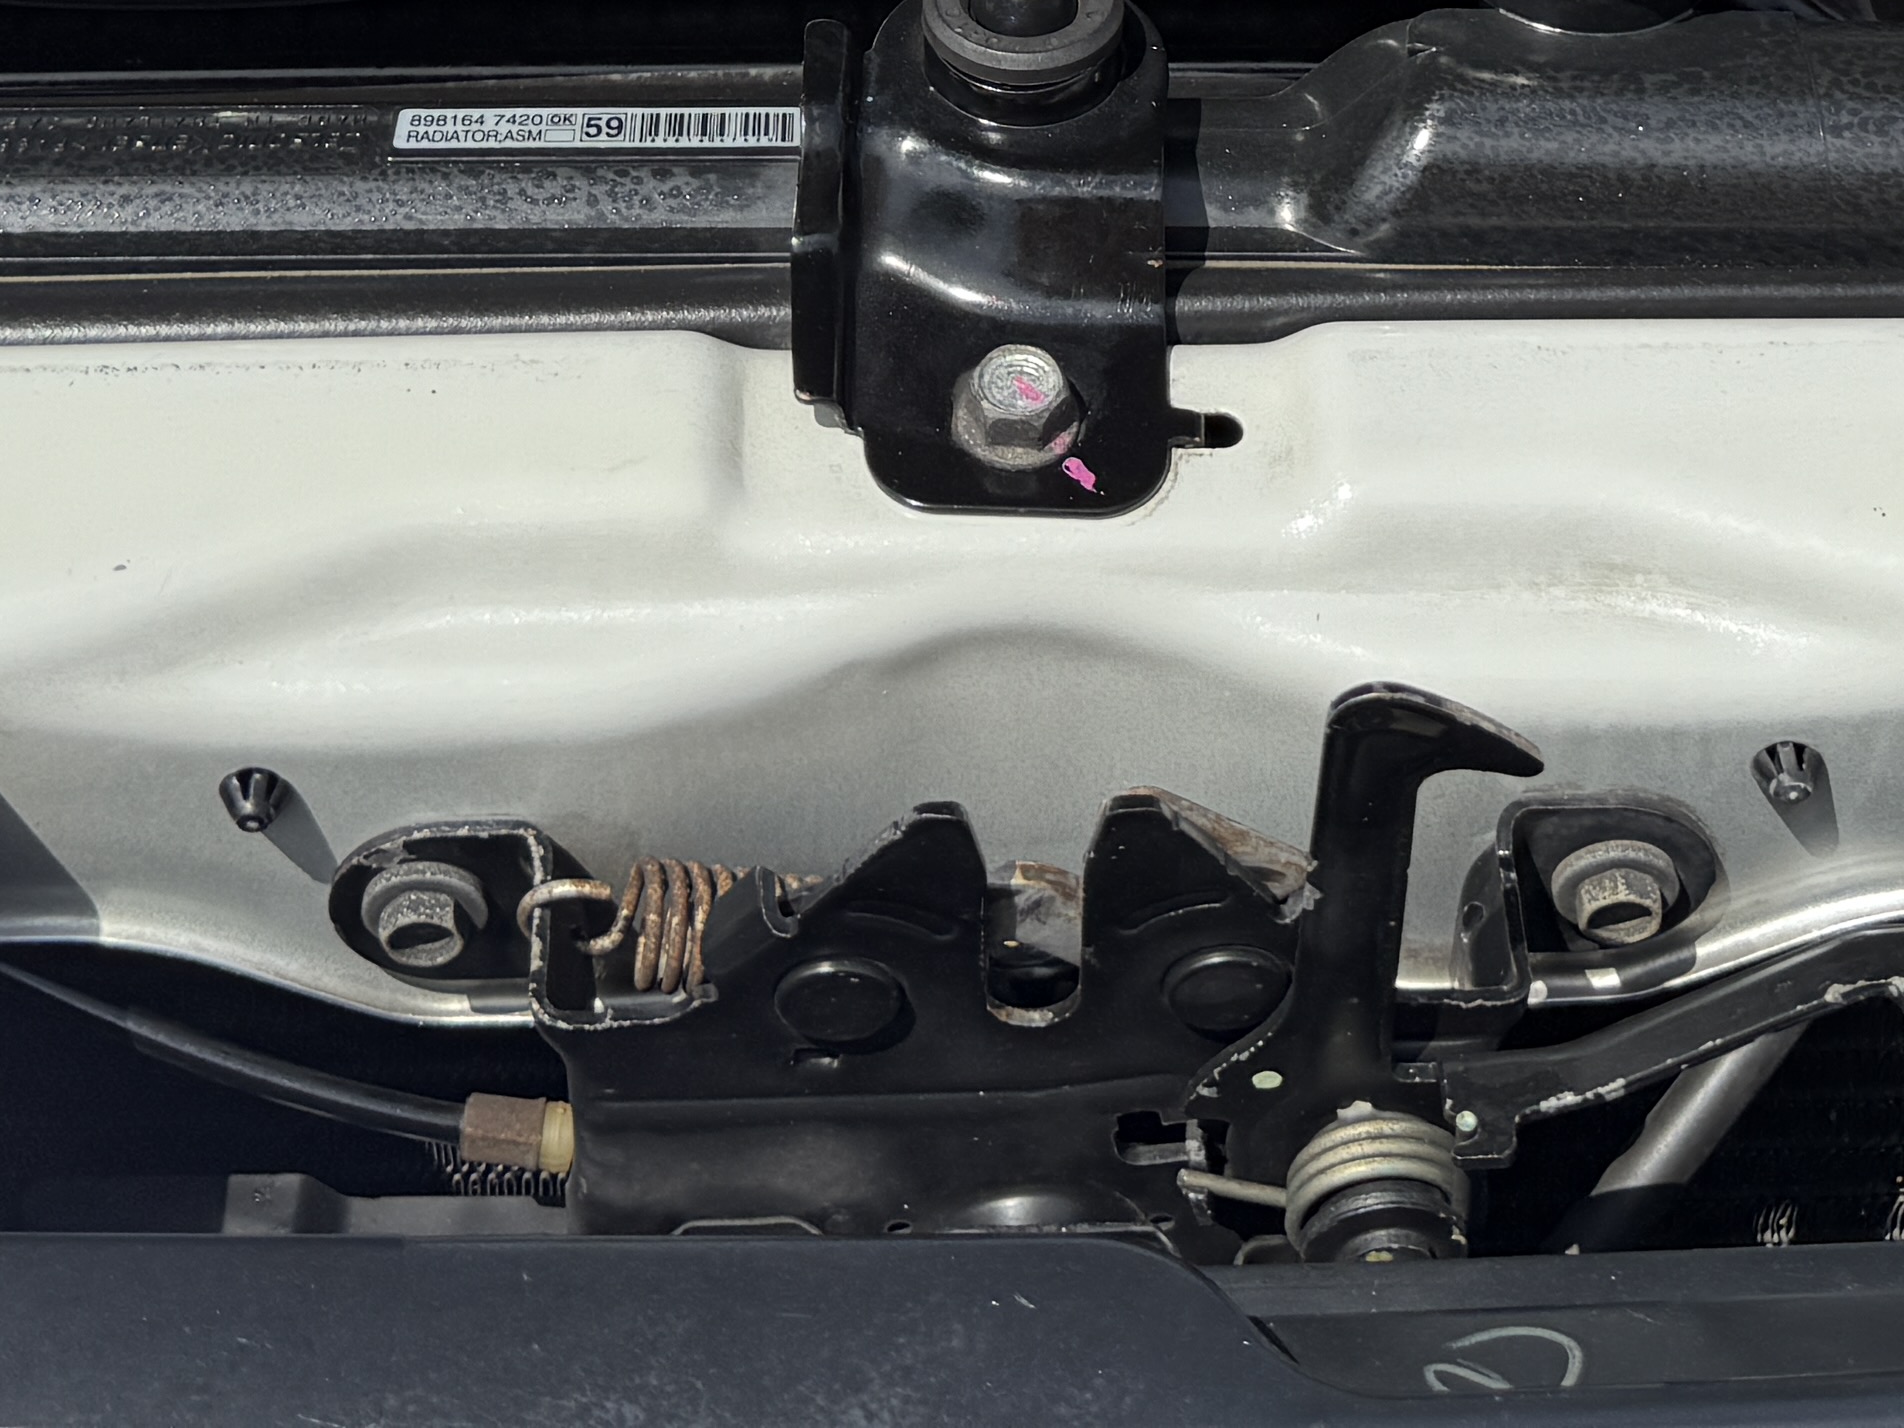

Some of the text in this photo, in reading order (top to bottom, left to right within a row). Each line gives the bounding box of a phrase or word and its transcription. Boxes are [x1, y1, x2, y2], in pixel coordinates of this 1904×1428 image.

[408, 112, 624, 140] 898164 7420 OK 59
